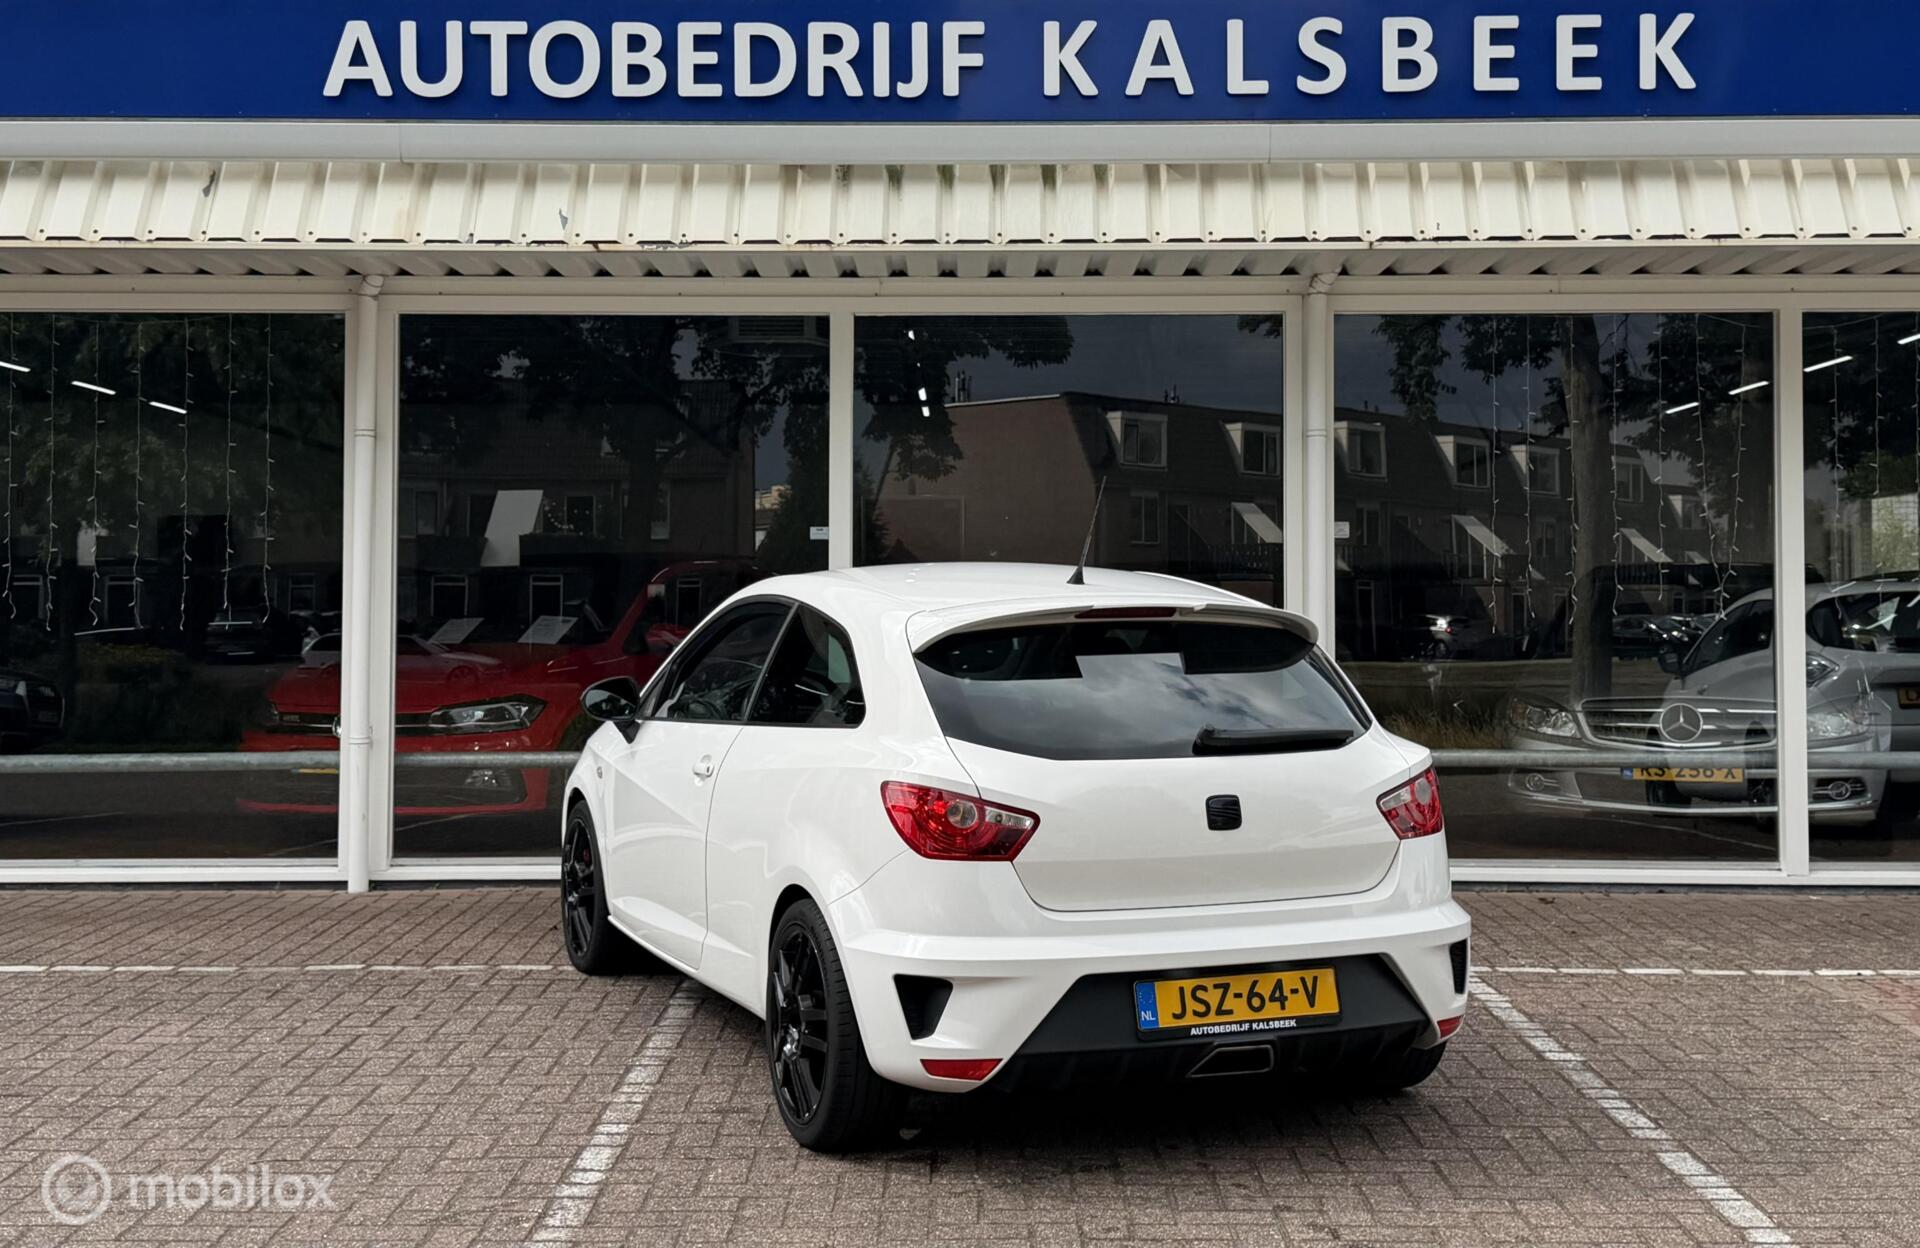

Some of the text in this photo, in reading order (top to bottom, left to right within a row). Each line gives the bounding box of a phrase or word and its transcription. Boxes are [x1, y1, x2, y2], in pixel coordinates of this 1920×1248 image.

[323, 13, 1696, 97] AUTOBEDRIJF KALSBEEK
[1141, 975, 1319, 1021] NL JSZ-64-V
[1190, 1018, 1297, 1036] AUTOBEDRIJF KALSBEEK
